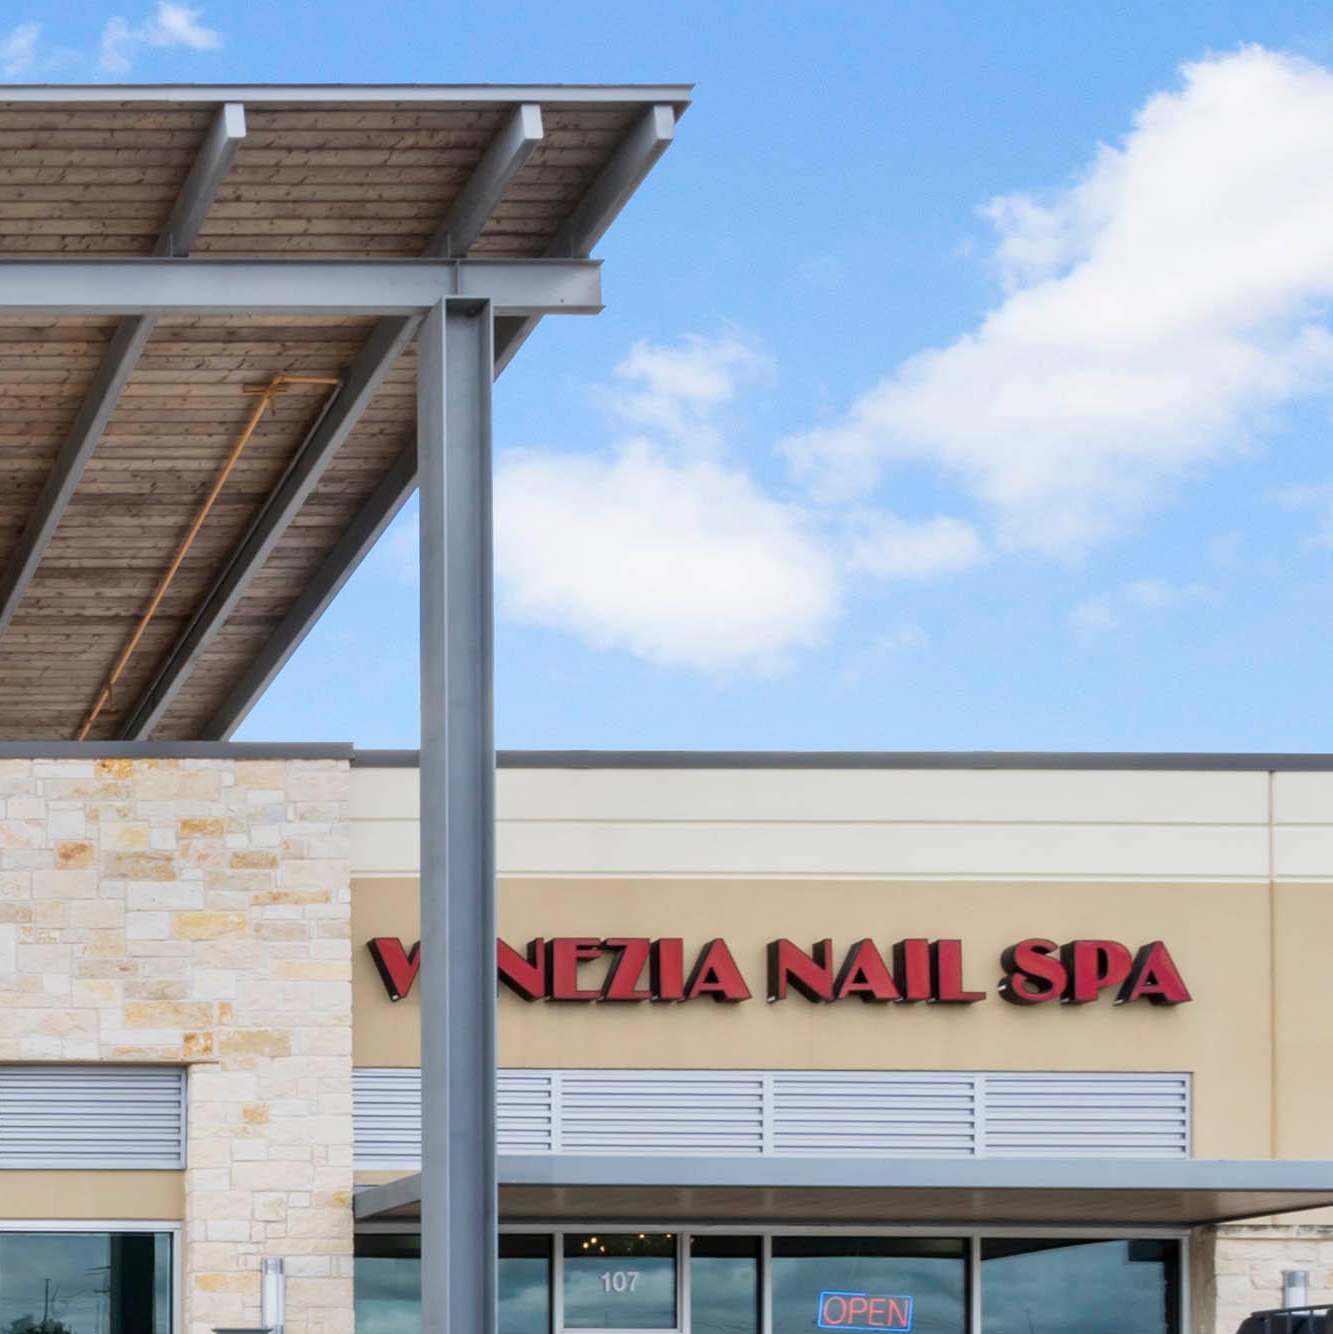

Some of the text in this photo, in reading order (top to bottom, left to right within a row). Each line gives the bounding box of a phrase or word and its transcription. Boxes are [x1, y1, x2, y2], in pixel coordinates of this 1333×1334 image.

[366, 937, 1193, 1006] VNEZIA NAIL SPA
[601, 1271, 640, 1292] 107
[823, 1295, 909, 1328] OPEN
